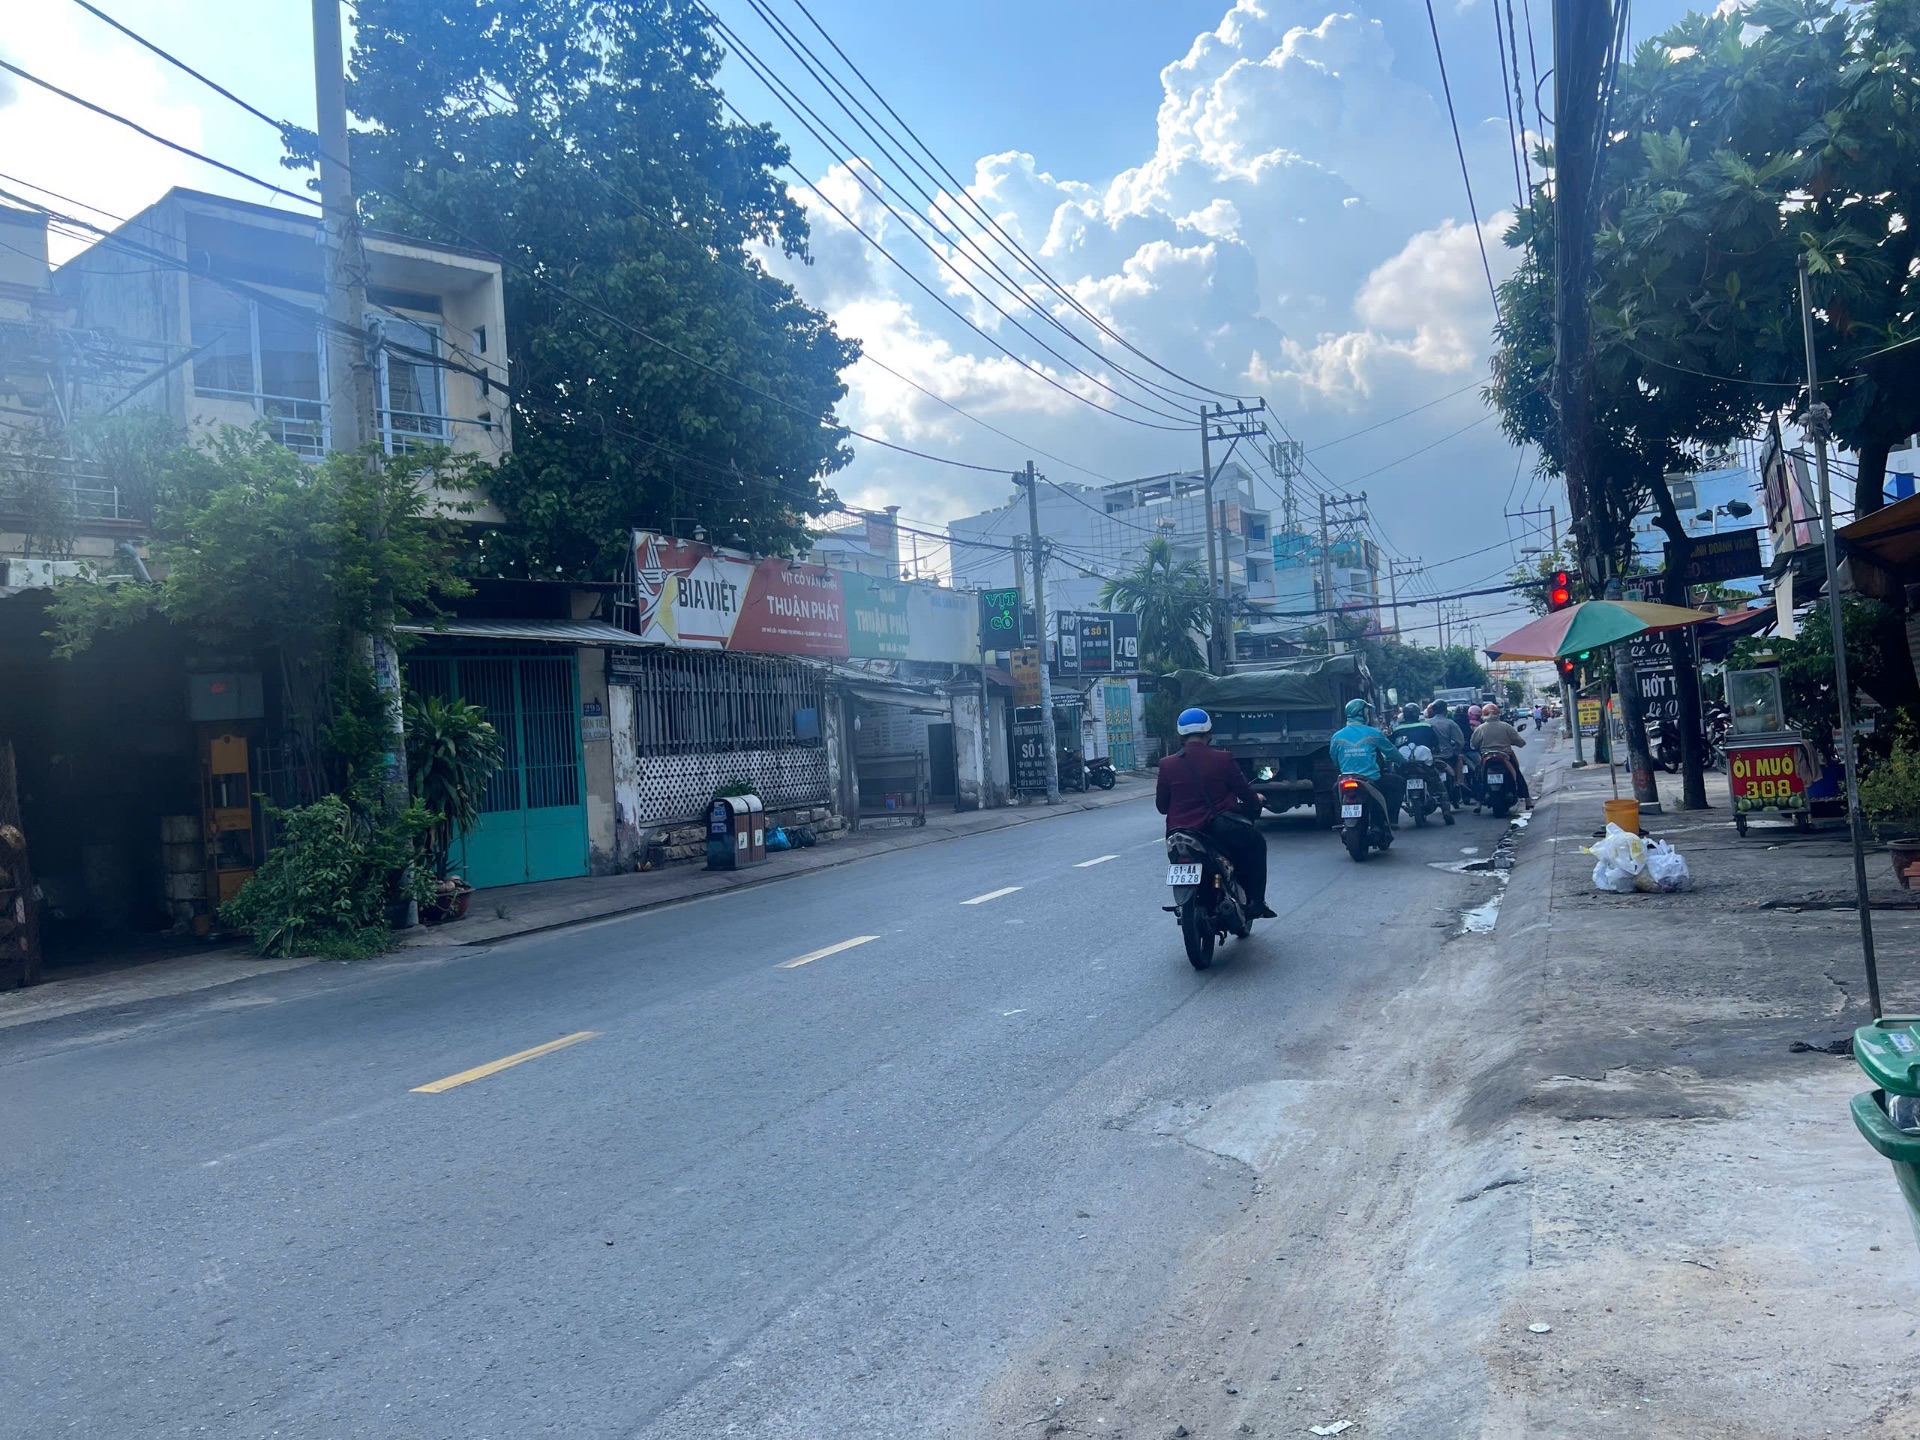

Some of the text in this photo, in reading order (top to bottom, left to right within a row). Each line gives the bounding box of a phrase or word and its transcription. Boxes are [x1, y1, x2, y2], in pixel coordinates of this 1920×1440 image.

[781, 571, 793, 586] VỊT
[678, 577, 737, 617] BIA VIỆT
[985, 592, 1017, 610] VỊT
[766, 594, 840, 622] THUẬN PHÁT
[990, 610, 1014, 630] CỎ
[1642, 673, 1665, 698] HỚT
[584, 704, 601, 712] 295
[1646, 702, 1662, 718] Lê
[1021, 738, 1044, 758] SỐ 1
[1733, 751, 1794, 778] ỔI MUỐ
[1746, 779, 1791, 799] 308
[1174, 865, 1196, 874] 61-AA
